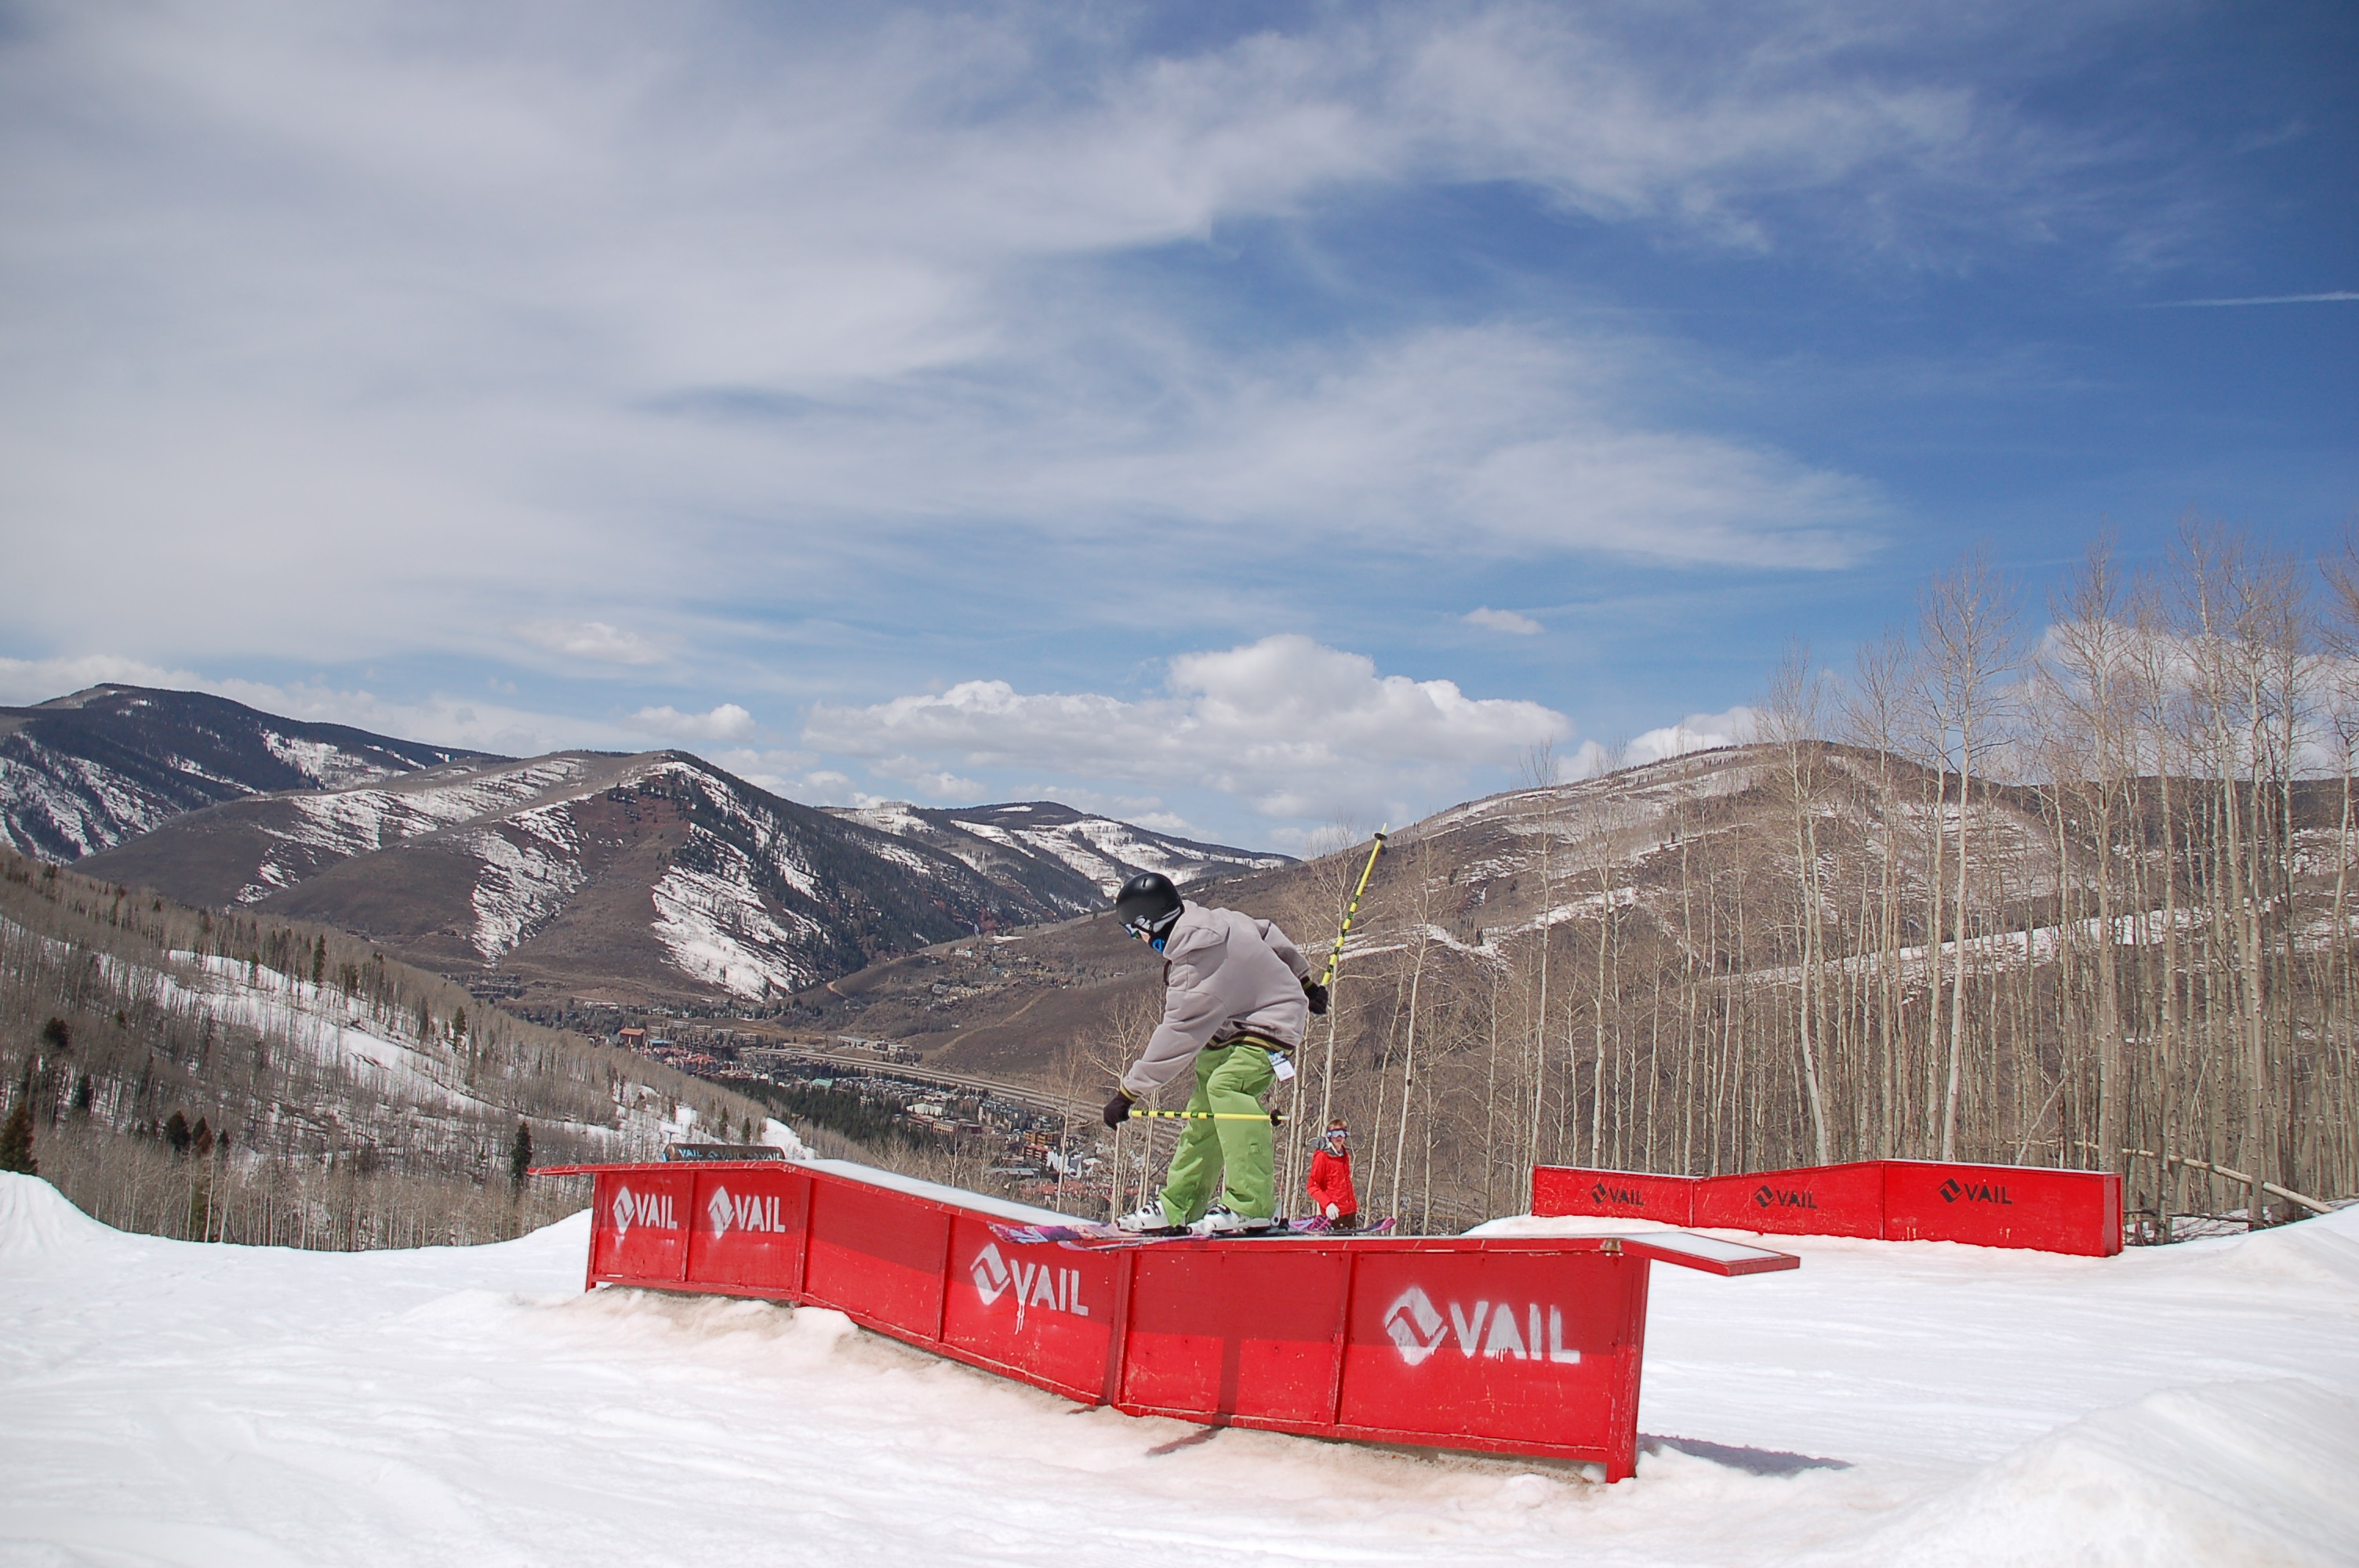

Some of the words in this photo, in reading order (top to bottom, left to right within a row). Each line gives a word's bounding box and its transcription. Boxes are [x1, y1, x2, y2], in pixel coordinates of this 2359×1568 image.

[678, 1149, 703, 1157] VAIL
[1609, 1188, 1645, 1206] VAIL
[1776, 1189, 1817, 1208] VAIL
[1964, 1183, 2012, 1204] VAIL
[635, 1193, 678, 1229] VAIL
[735, 1194, 785, 1232] VAIL
[1010, 1259, 1089, 1316] VAIL
[1449, 1301, 1580, 1364] VAIL
